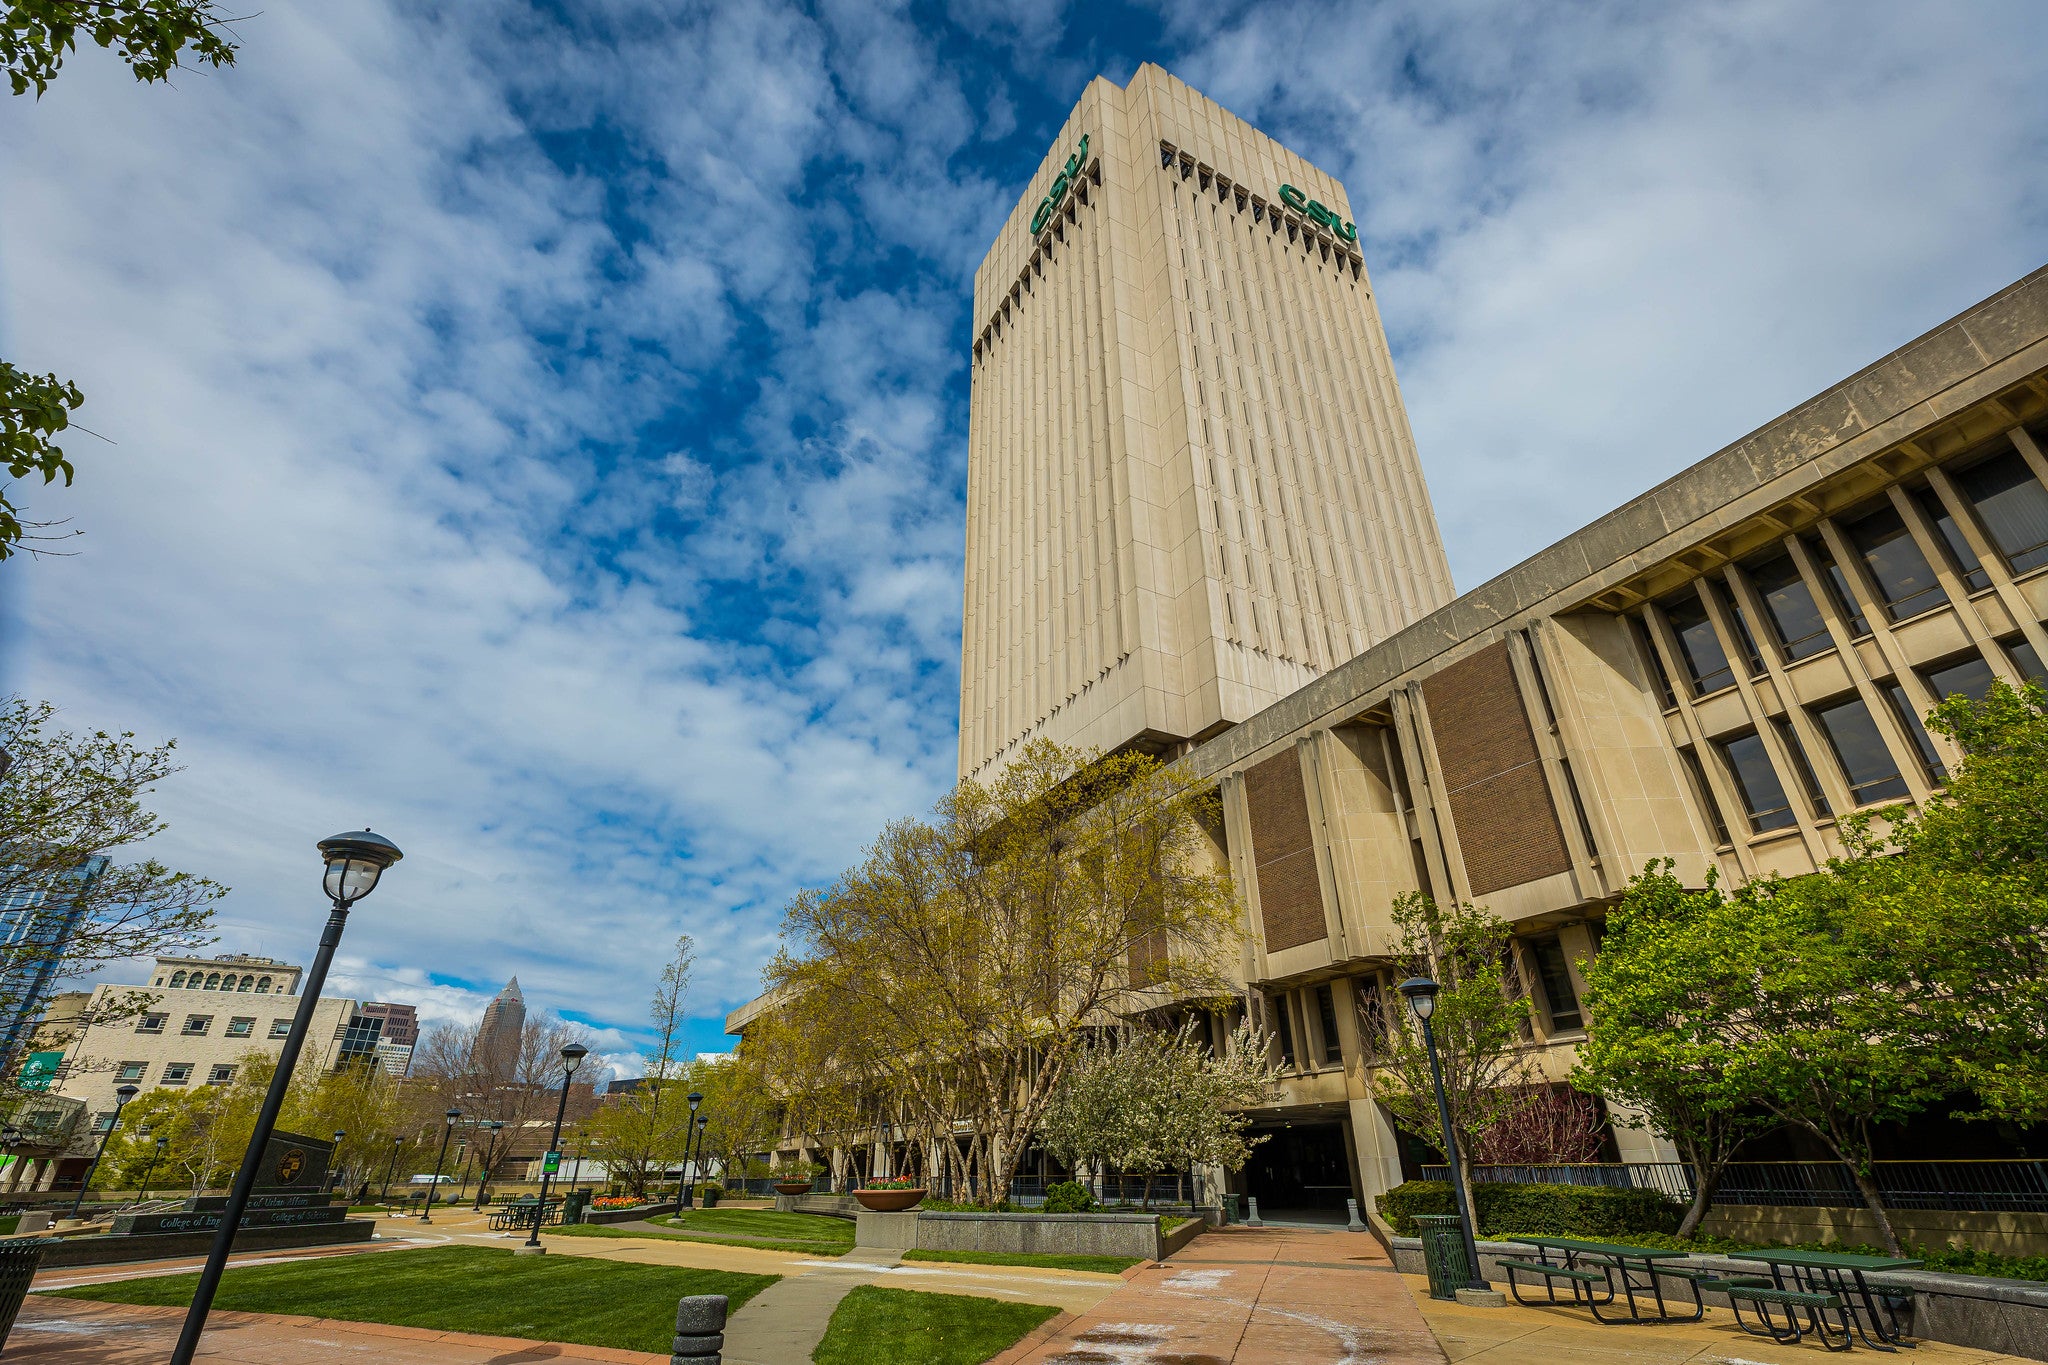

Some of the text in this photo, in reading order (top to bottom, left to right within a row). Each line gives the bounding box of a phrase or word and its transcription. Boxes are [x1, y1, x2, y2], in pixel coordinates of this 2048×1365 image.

[1030, 133, 1089, 235] CSU
[1278, 184, 1356, 243] CSU
[160, 1217, 191, 1230] College
[193, 1215, 205, 1226] of
[271, 1212, 295, 1224] College
[297, 1211, 306, 1221] of
